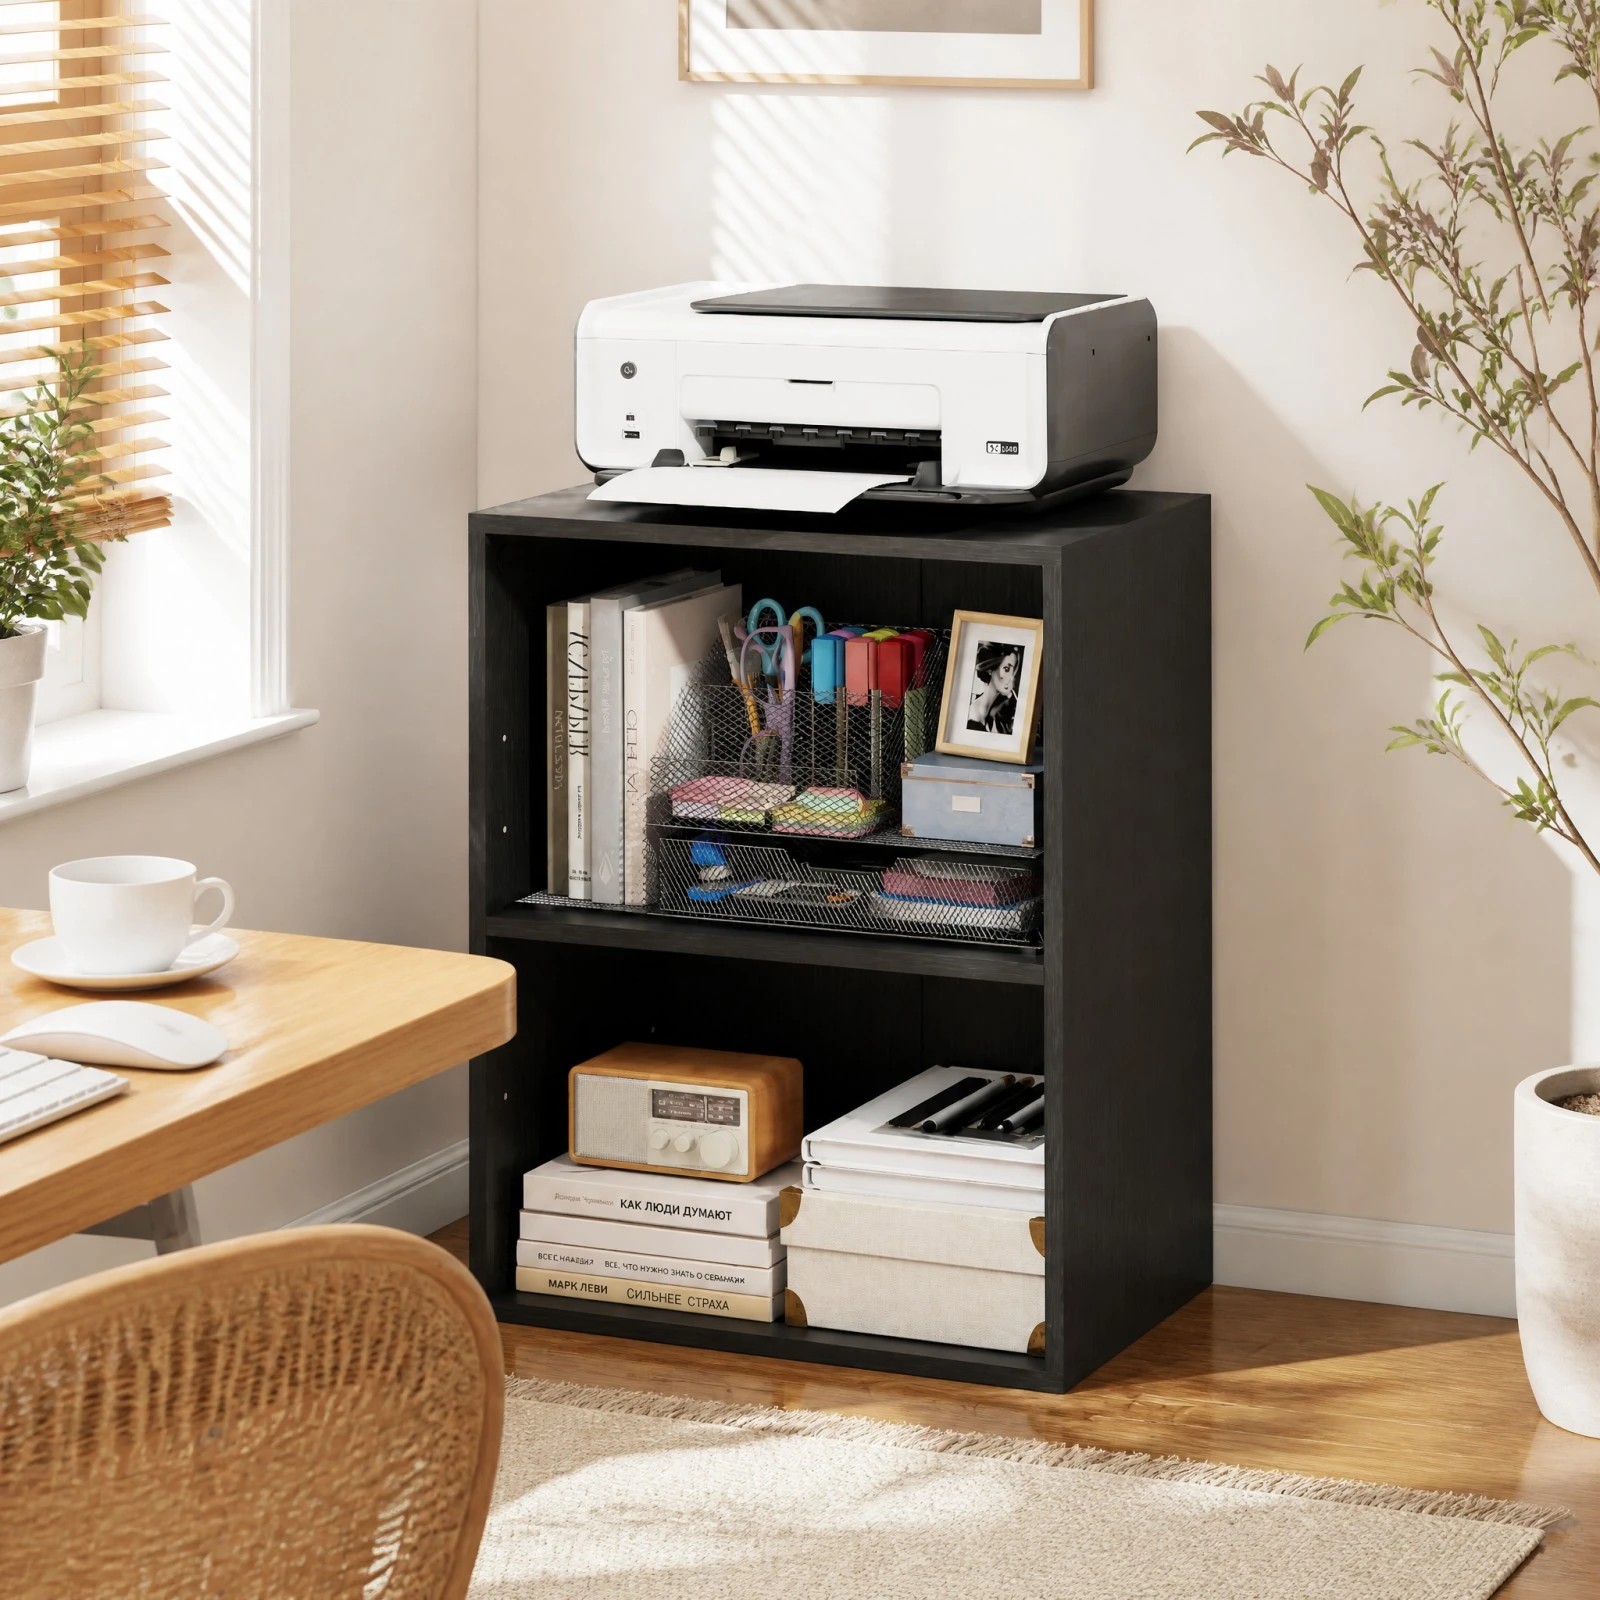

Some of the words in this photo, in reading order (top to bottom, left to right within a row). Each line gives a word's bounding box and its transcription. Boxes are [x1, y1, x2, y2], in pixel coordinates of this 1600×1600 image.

[620, 1198, 643, 1211] КАК
[644, 1201, 681, 1217] ЛЮДИ
[682, 1205, 733, 1222] ДУМАЮТ
[622, 1262, 639, 1272] ЧТО
[640, 1264, 669, 1276] НУЖНО
[670, 1268, 695, 1279] ЗНАТЬ
[696, 1271, 704, 1281] О
[547, 1279, 578, 1292] МАРК
[579, 1282, 608, 1295] ЛЕВИ
[626, 1287, 682, 1305] СИЛЬНЕЕ
[687, 1296, 730, 1311] СТРАХА
